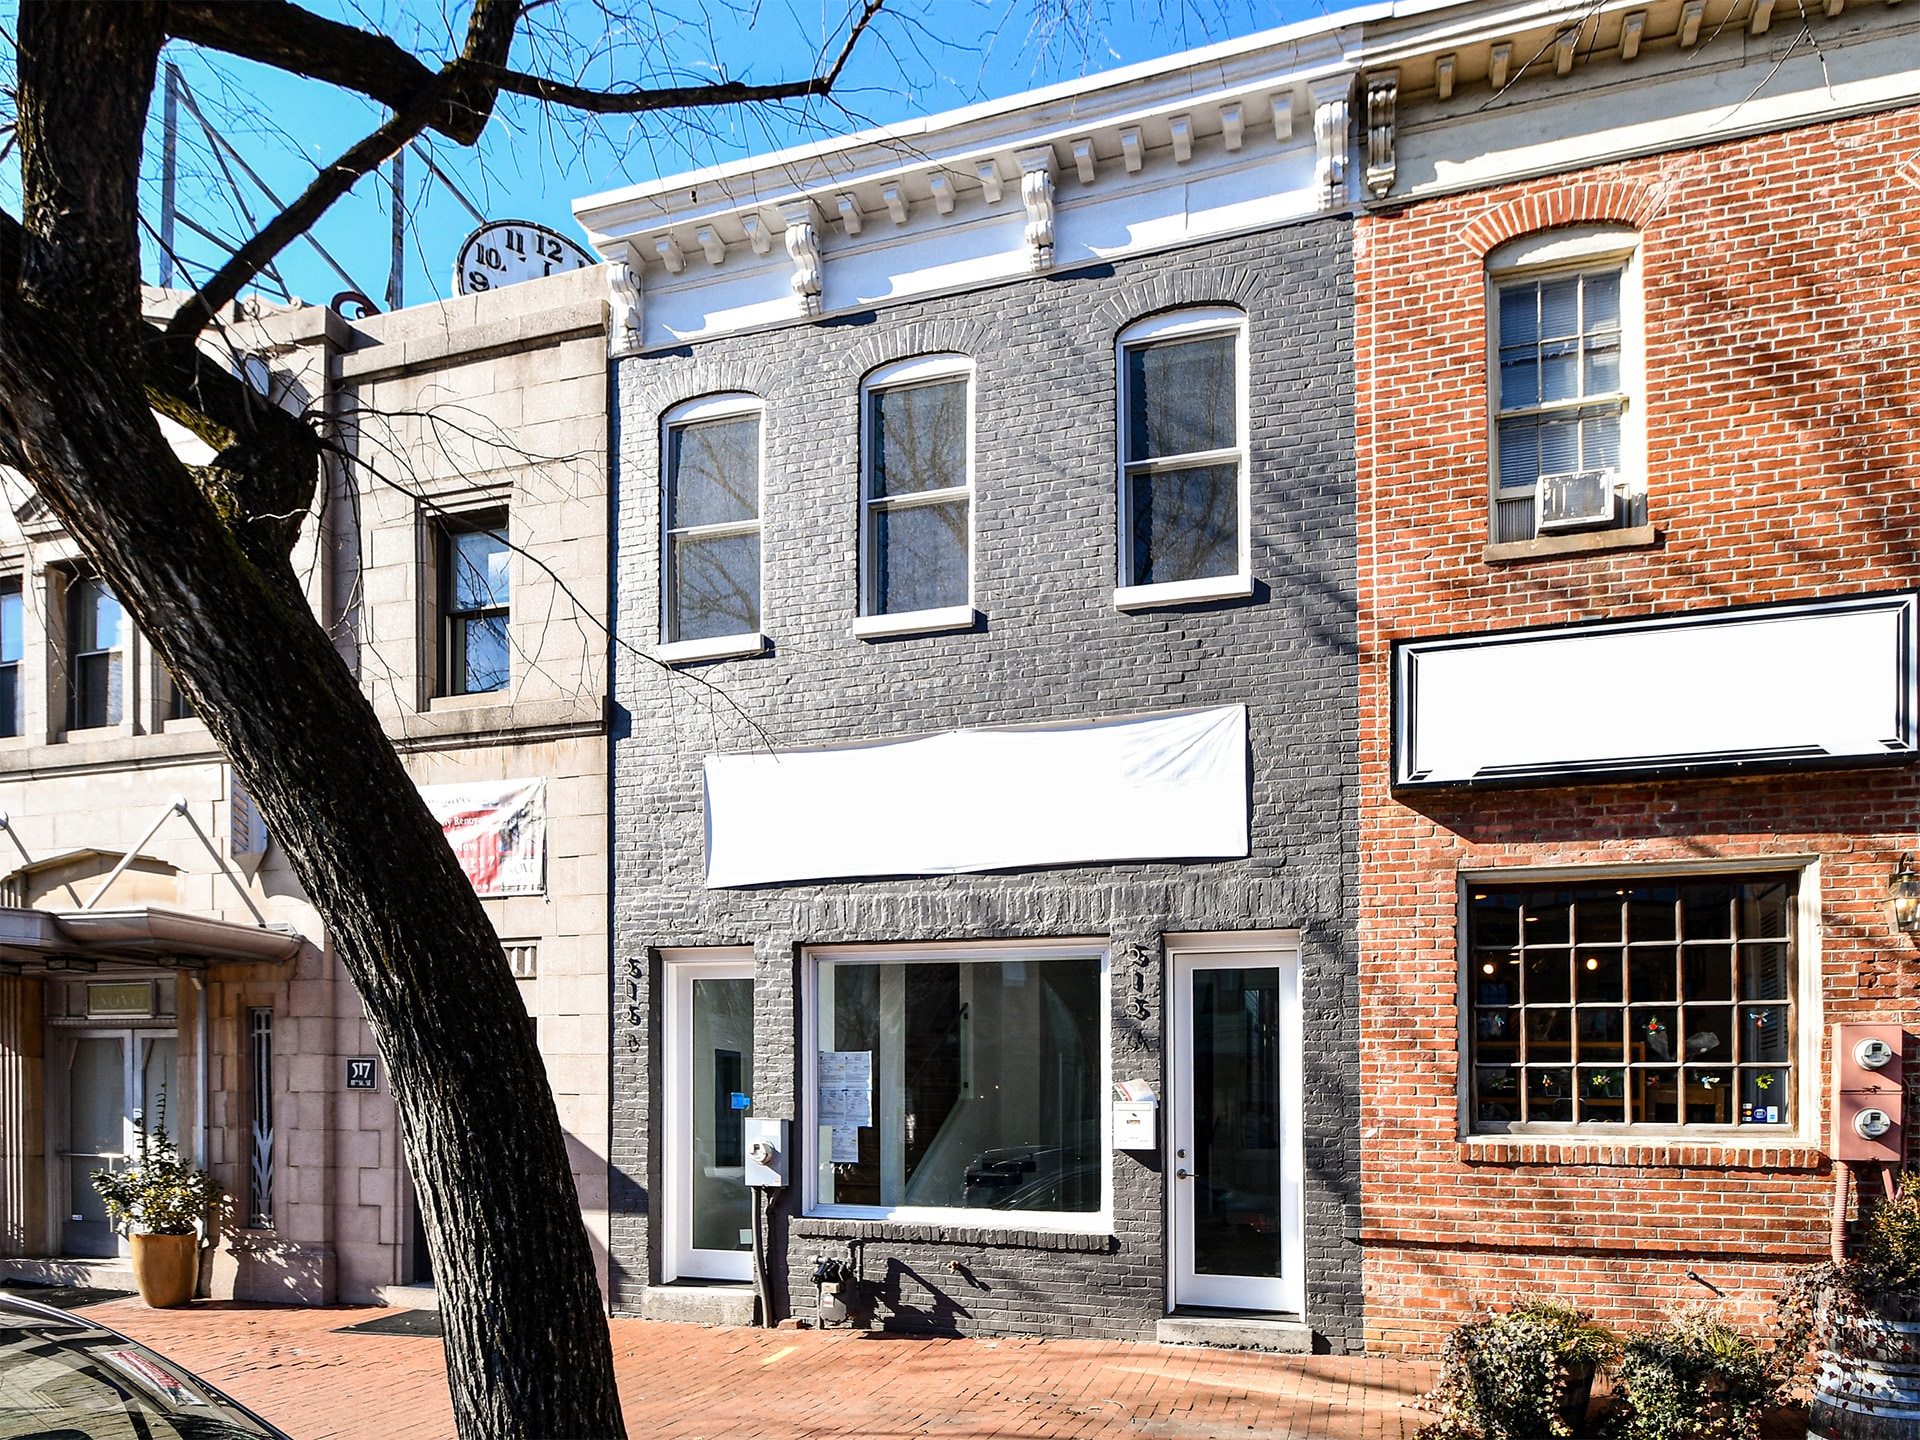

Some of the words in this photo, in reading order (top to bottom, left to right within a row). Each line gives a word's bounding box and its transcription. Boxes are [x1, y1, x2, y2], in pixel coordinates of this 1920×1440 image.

[475, 242, 502, 270] 10
[505, 228, 525, 256] 11
[536, 234, 564, 264] 12
[468, 271, 490, 293] 9
[351, 1061, 372, 1079] 517
